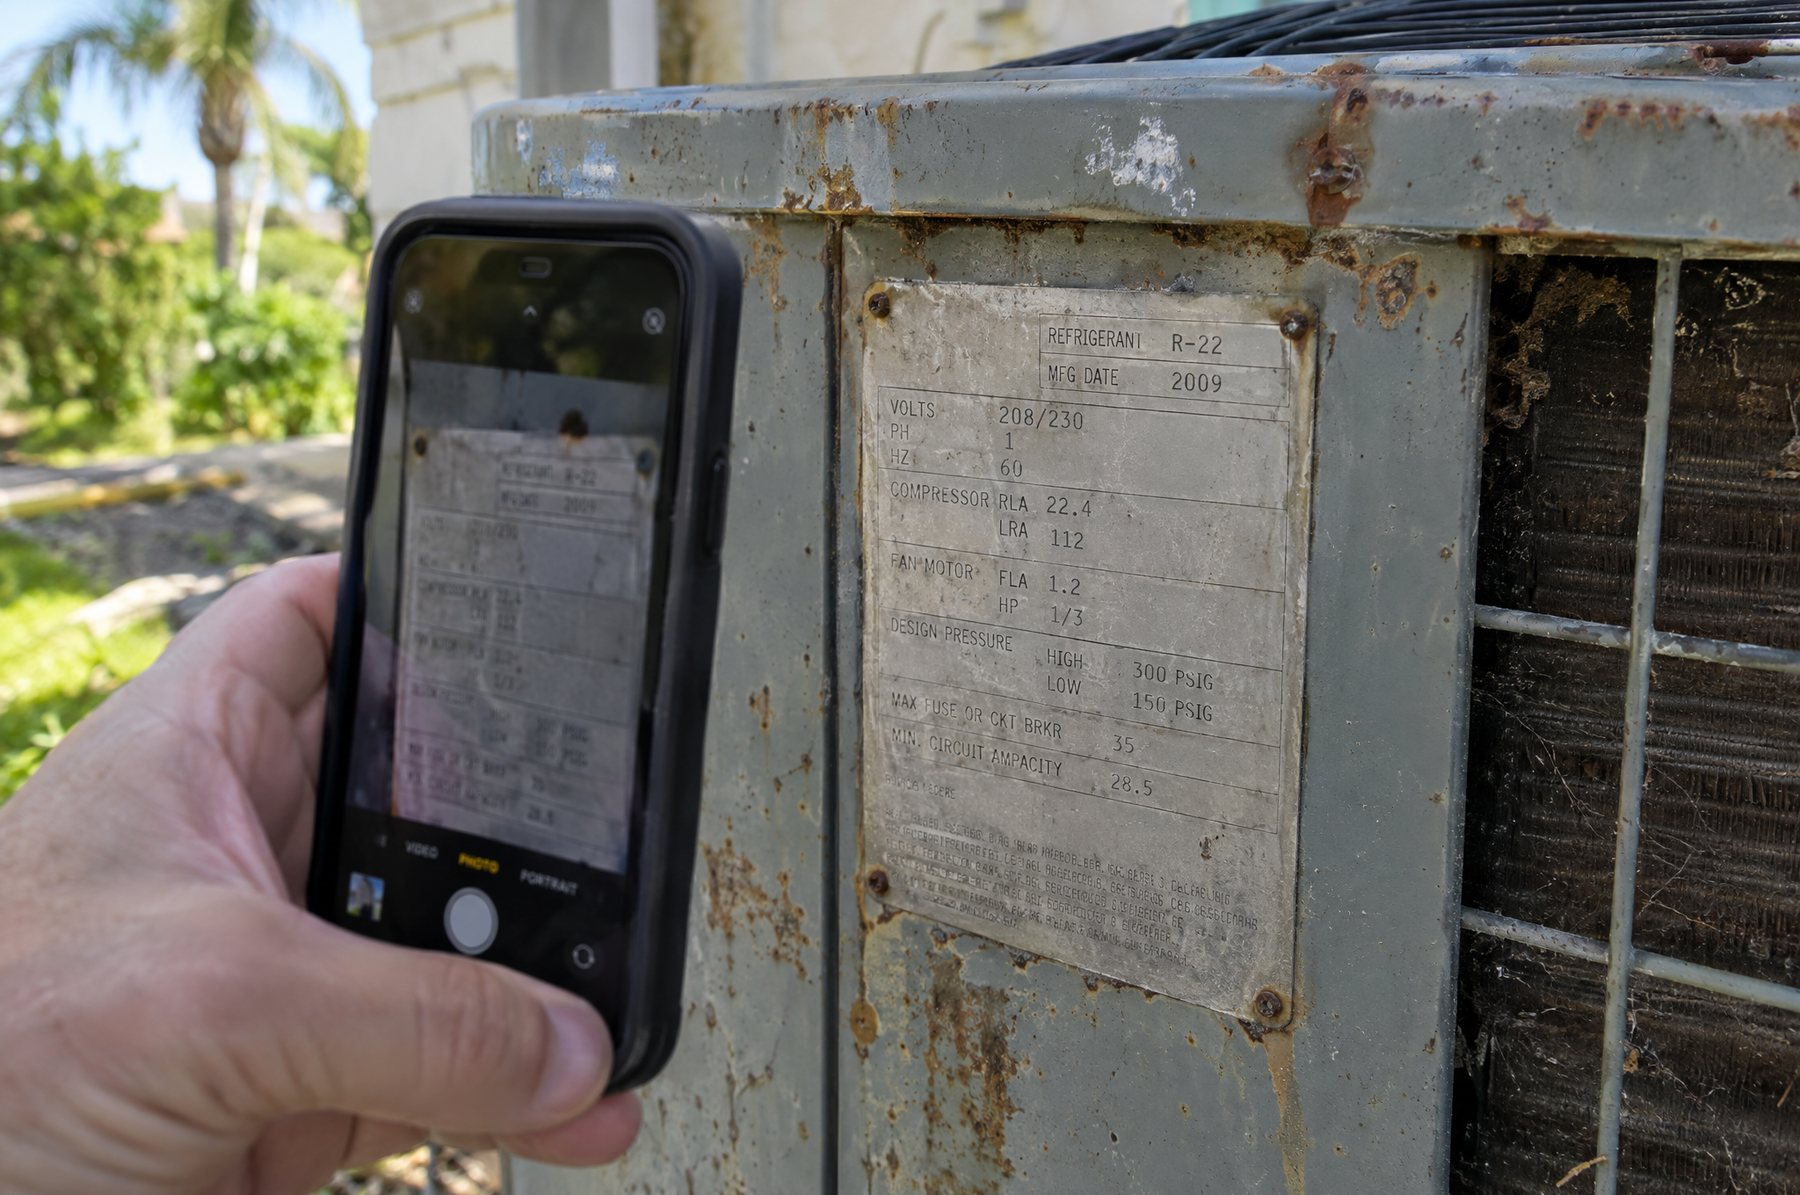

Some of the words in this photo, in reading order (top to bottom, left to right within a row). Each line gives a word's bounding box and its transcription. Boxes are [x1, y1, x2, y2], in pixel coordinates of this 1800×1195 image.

[1048, 327, 1142, 350] REFRIGERANT
[1171, 333, 1223, 355] R-22
[1048, 366, 1076, 384] MFG
[1084, 367, 1119, 387] DATE
[1171, 371, 1223, 393] 2009
[890, 400, 935, 419] VOLTS
[999, 406, 1084, 430] 208/230
[890, 424, 909, 441] PH
[1005, 432, 1014, 450] 1
[890, 449, 909, 466] HZ
[1001, 459, 1022, 478] 60
[890, 481, 989, 508] COMPRESSOR
[1000, 494, 1028, 512] RLA
[1047, 496, 1092, 518] 22.4
[1000, 520, 1028, 539] LRA
[1051, 529, 1084, 551] 112
[890, 553, 918, 573] FAN
[925, 558, 973, 581] MOTOR
[1000, 570, 1028, 590] FLA
[1049, 575, 1081, 596] 1.2
[1000, 597, 1019, 615] HP
[1051, 605, 1084, 627] 1/3
[890, 617, 938, 640] DESIGN
[945, 626, 1013, 652] PRESSURE
[1047, 648, 1083, 669] HIGH
[1132, 662, 1167, 684] 300
[1175, 669, 1214, 691] PSIG
[1047, 675, 1081, 696] LOW
[1132, 692, 1166, 714] 150
[1175, 701, 1213, 722] PSIG
[891, 692, 917, 711] MAX
[925, 698, 958, 720] FUSE
[965, 706, 983, 724] OR
[991, 711, 1017, 731] CKT
[1024, 717, 1062, 740] BRKR
[1113, 735, 1135, 754] 35
[929, 735, 985, 760] CIRCUIT
[992, 747, 1062, 777] AMPACITY
[1111, 774, 1153, 797] 28.5
[405, 841, 439, 859] VIDEO
[458, 852, 499, 874] PHOTO
[520, 869, 579, 895] PORTRAIT
